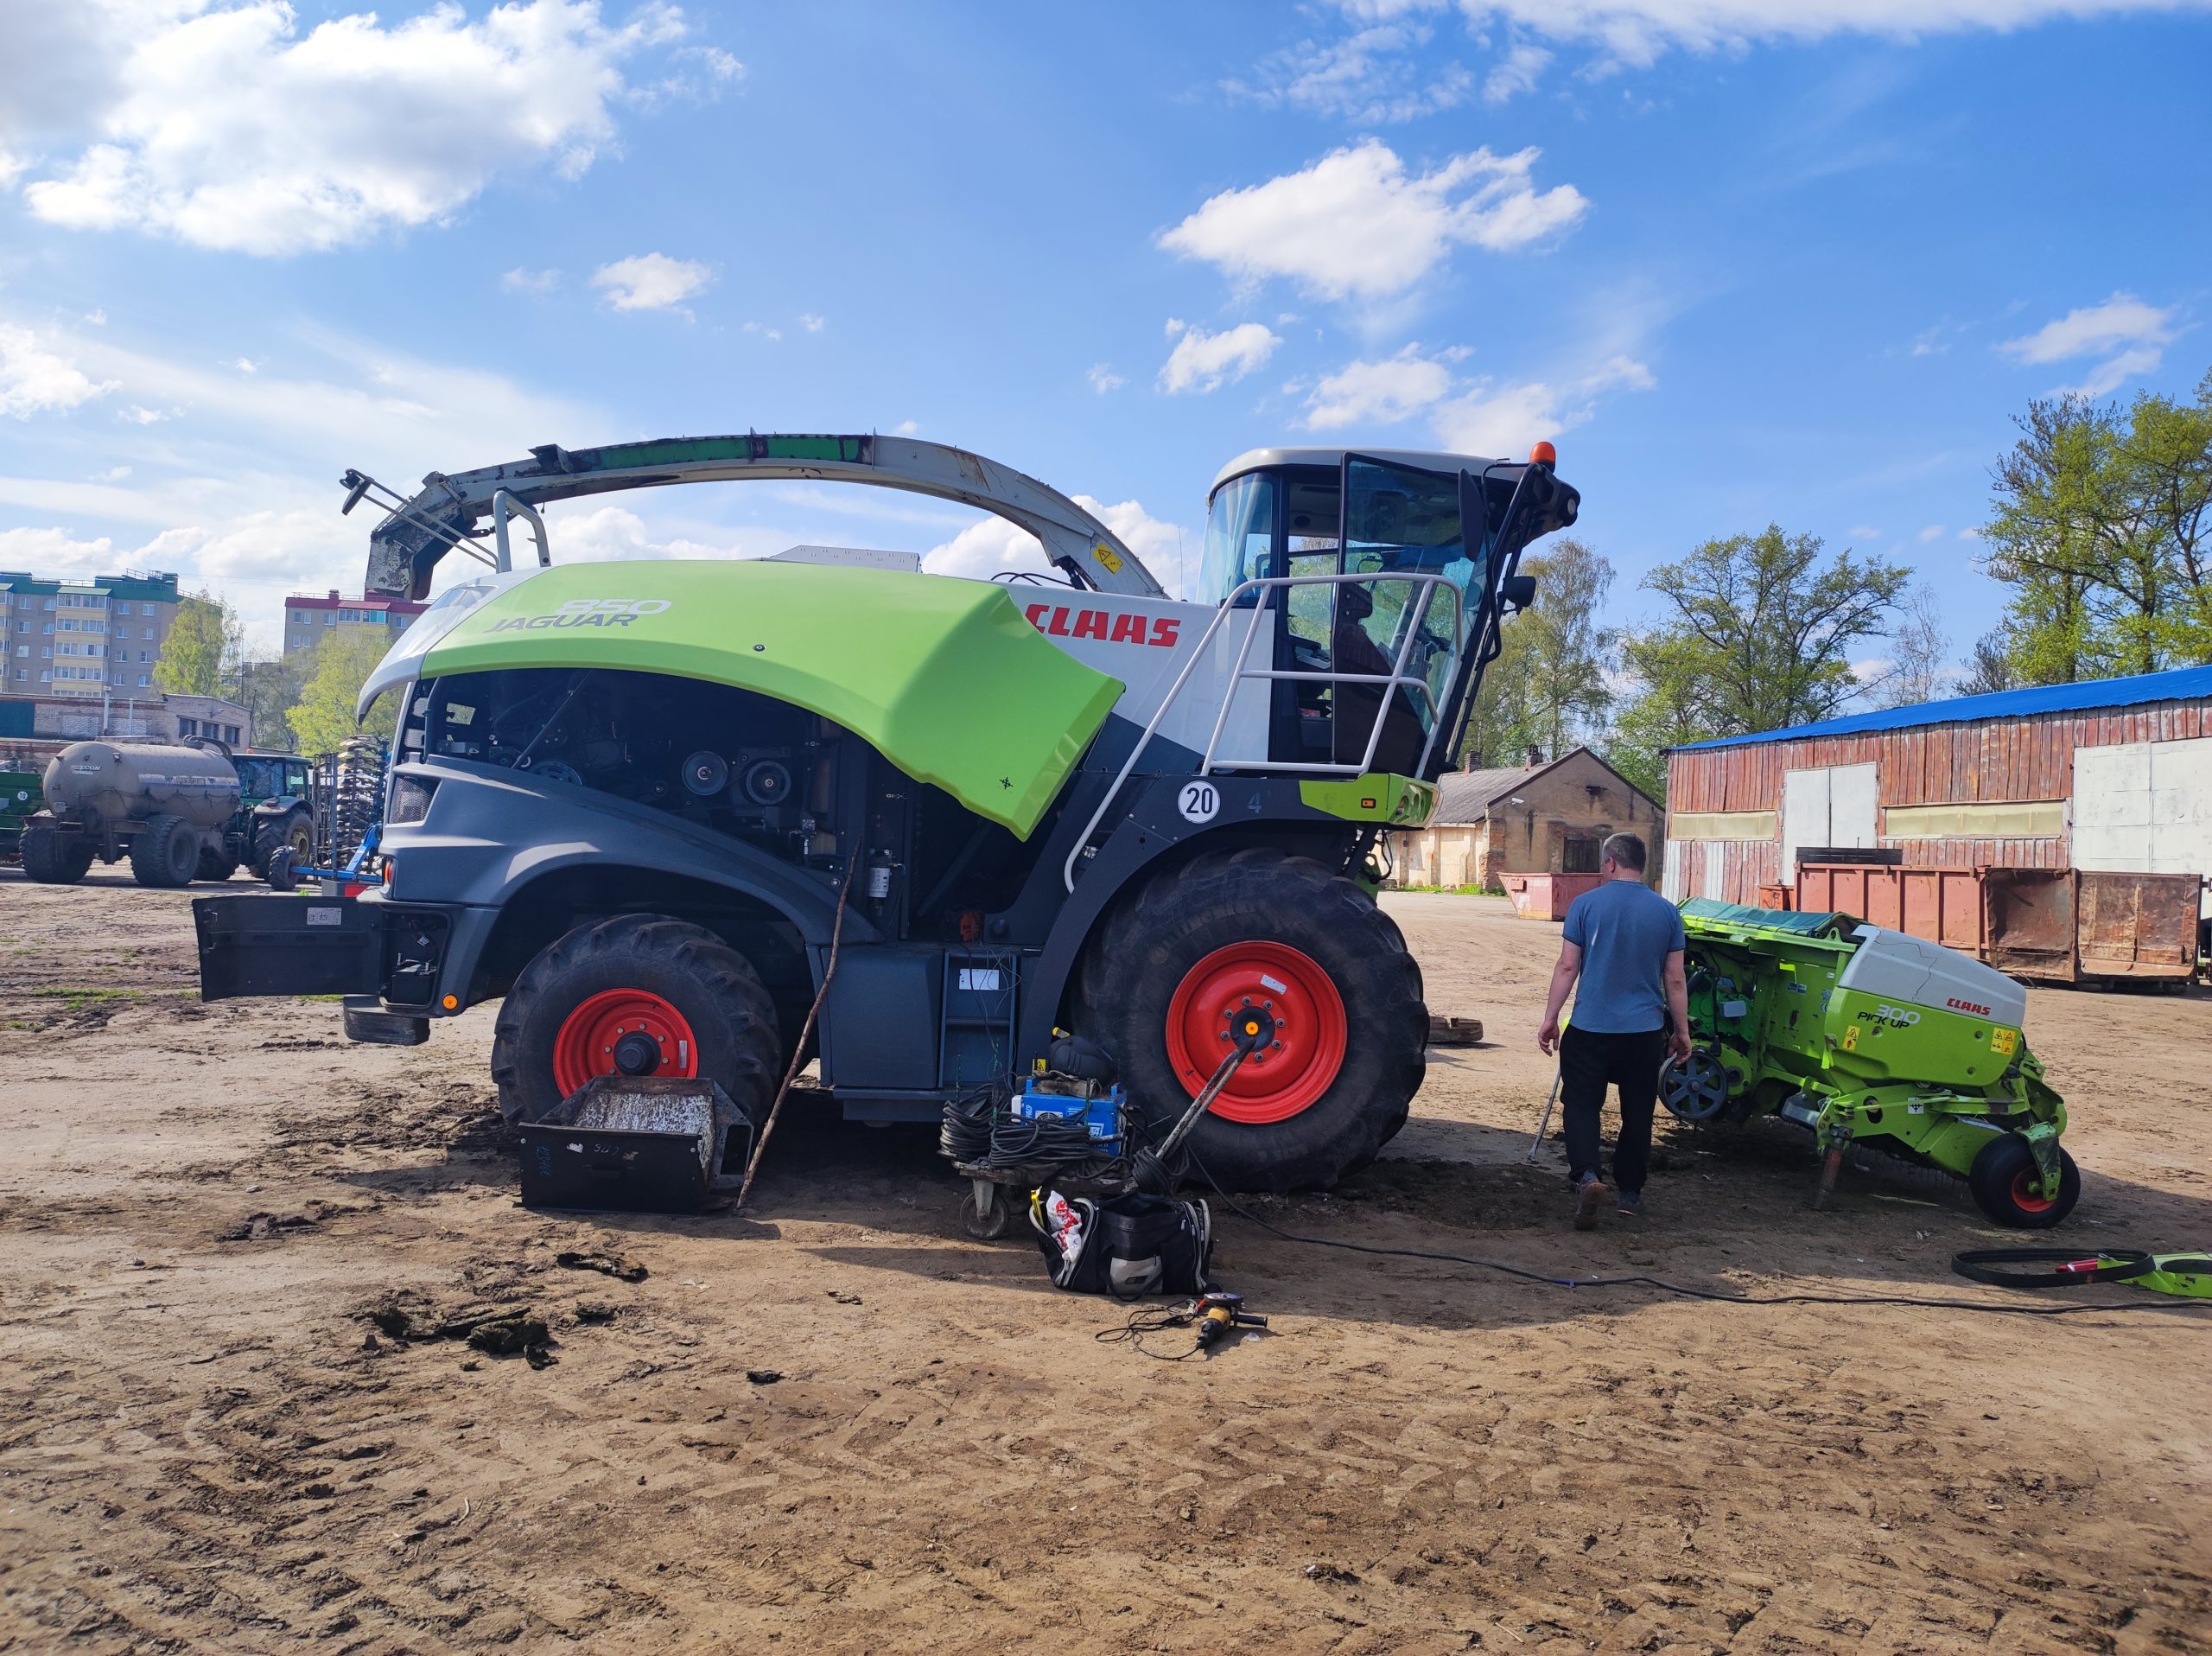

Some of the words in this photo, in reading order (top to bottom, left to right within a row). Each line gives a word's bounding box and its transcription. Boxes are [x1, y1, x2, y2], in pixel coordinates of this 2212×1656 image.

[556, 599, 672, 615] 850
[482, 614, 638, 634] JAGUAR
[1025, 603, 1181, 647] CLAAS
[1186, 787, 1213, 814] 20
[1247, 793, 1262, 814] 4
[1873, 1003, 1921, 1024] 300
[1946, 997, 1992, 1016] CLAAS
[1857, 1011, 1888, 1026] PICK
[1890, 1018, 1910, 1029] UP
